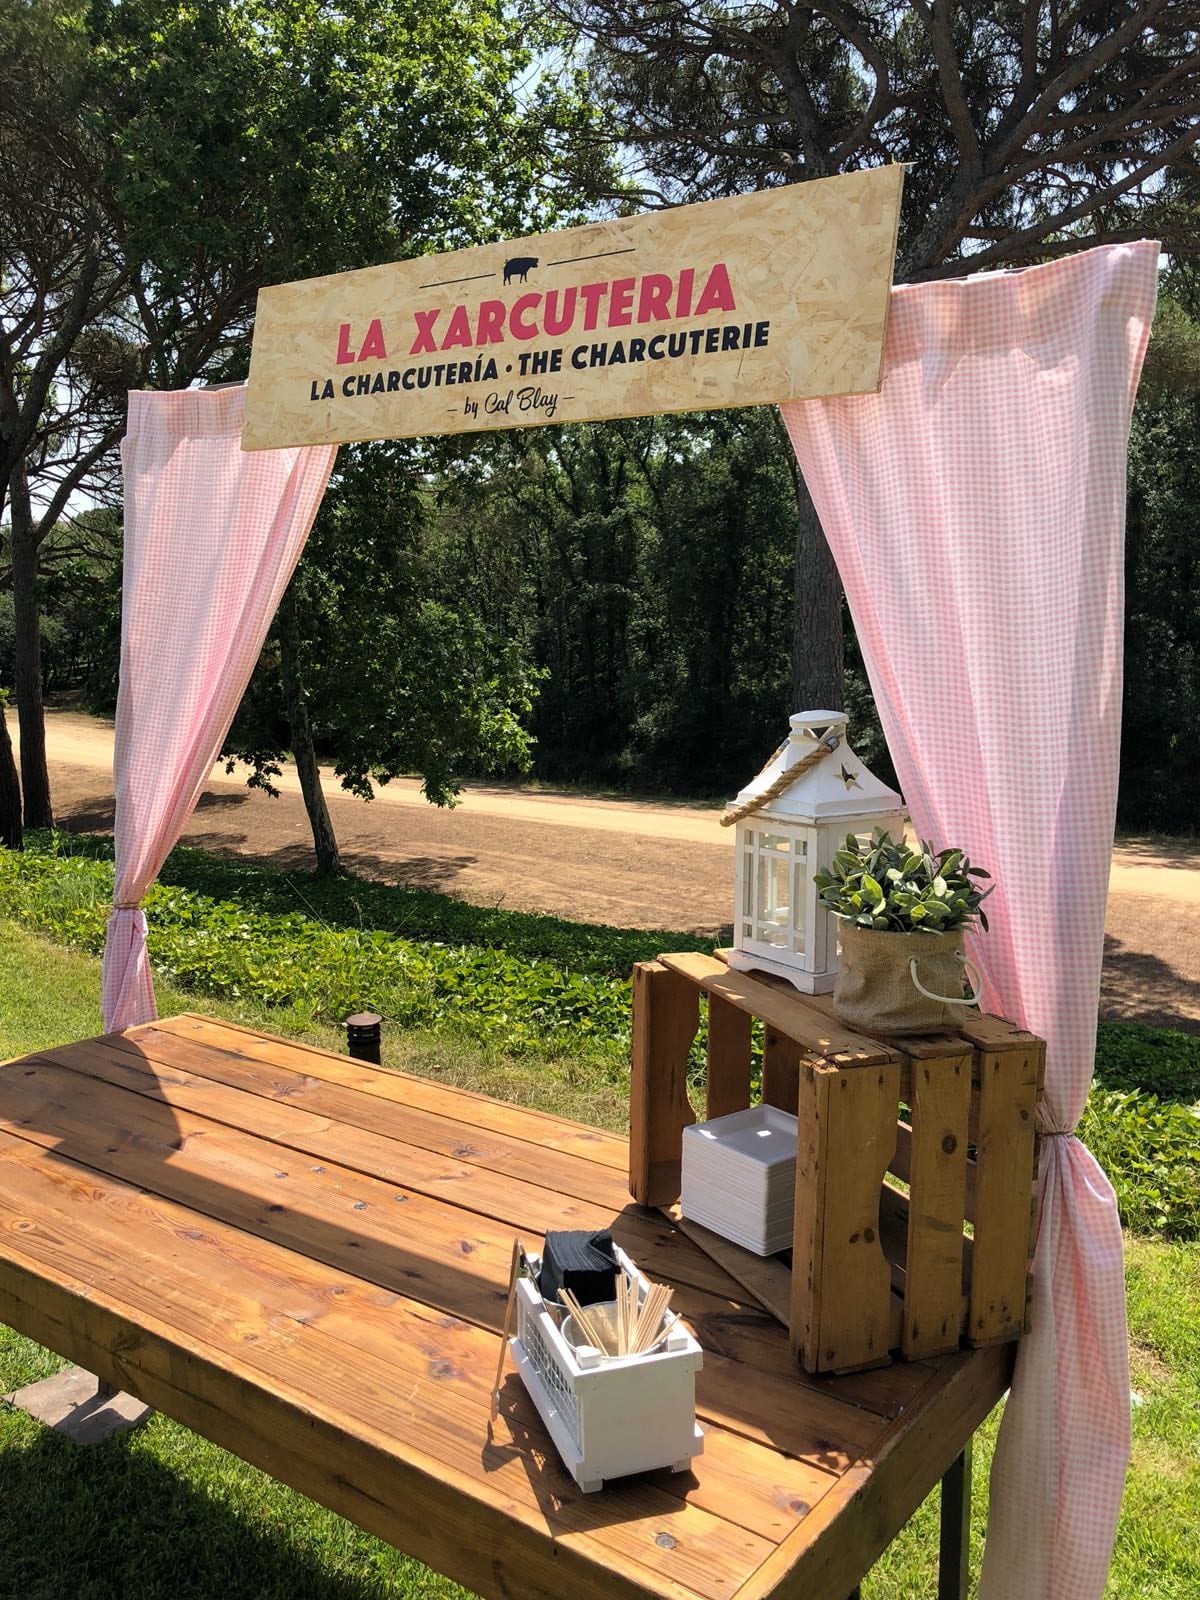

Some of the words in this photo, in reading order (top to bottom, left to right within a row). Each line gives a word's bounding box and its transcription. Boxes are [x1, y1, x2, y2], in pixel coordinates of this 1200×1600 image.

[336, 319, 387, 365] LA
[409, 263, 736, 355] XARCUTERIA
[310, 378, 335, 401] LA
[342, 353, 498, 397] CHARCUTERÍA
[518, 348, 562, 376] THE
[570, 320, 771, 370] CHARCUTERIE
[463, 396, 479, 420] by
[484, 390, 514, 415] Cal
[516, 386, 559, 418] Blay
